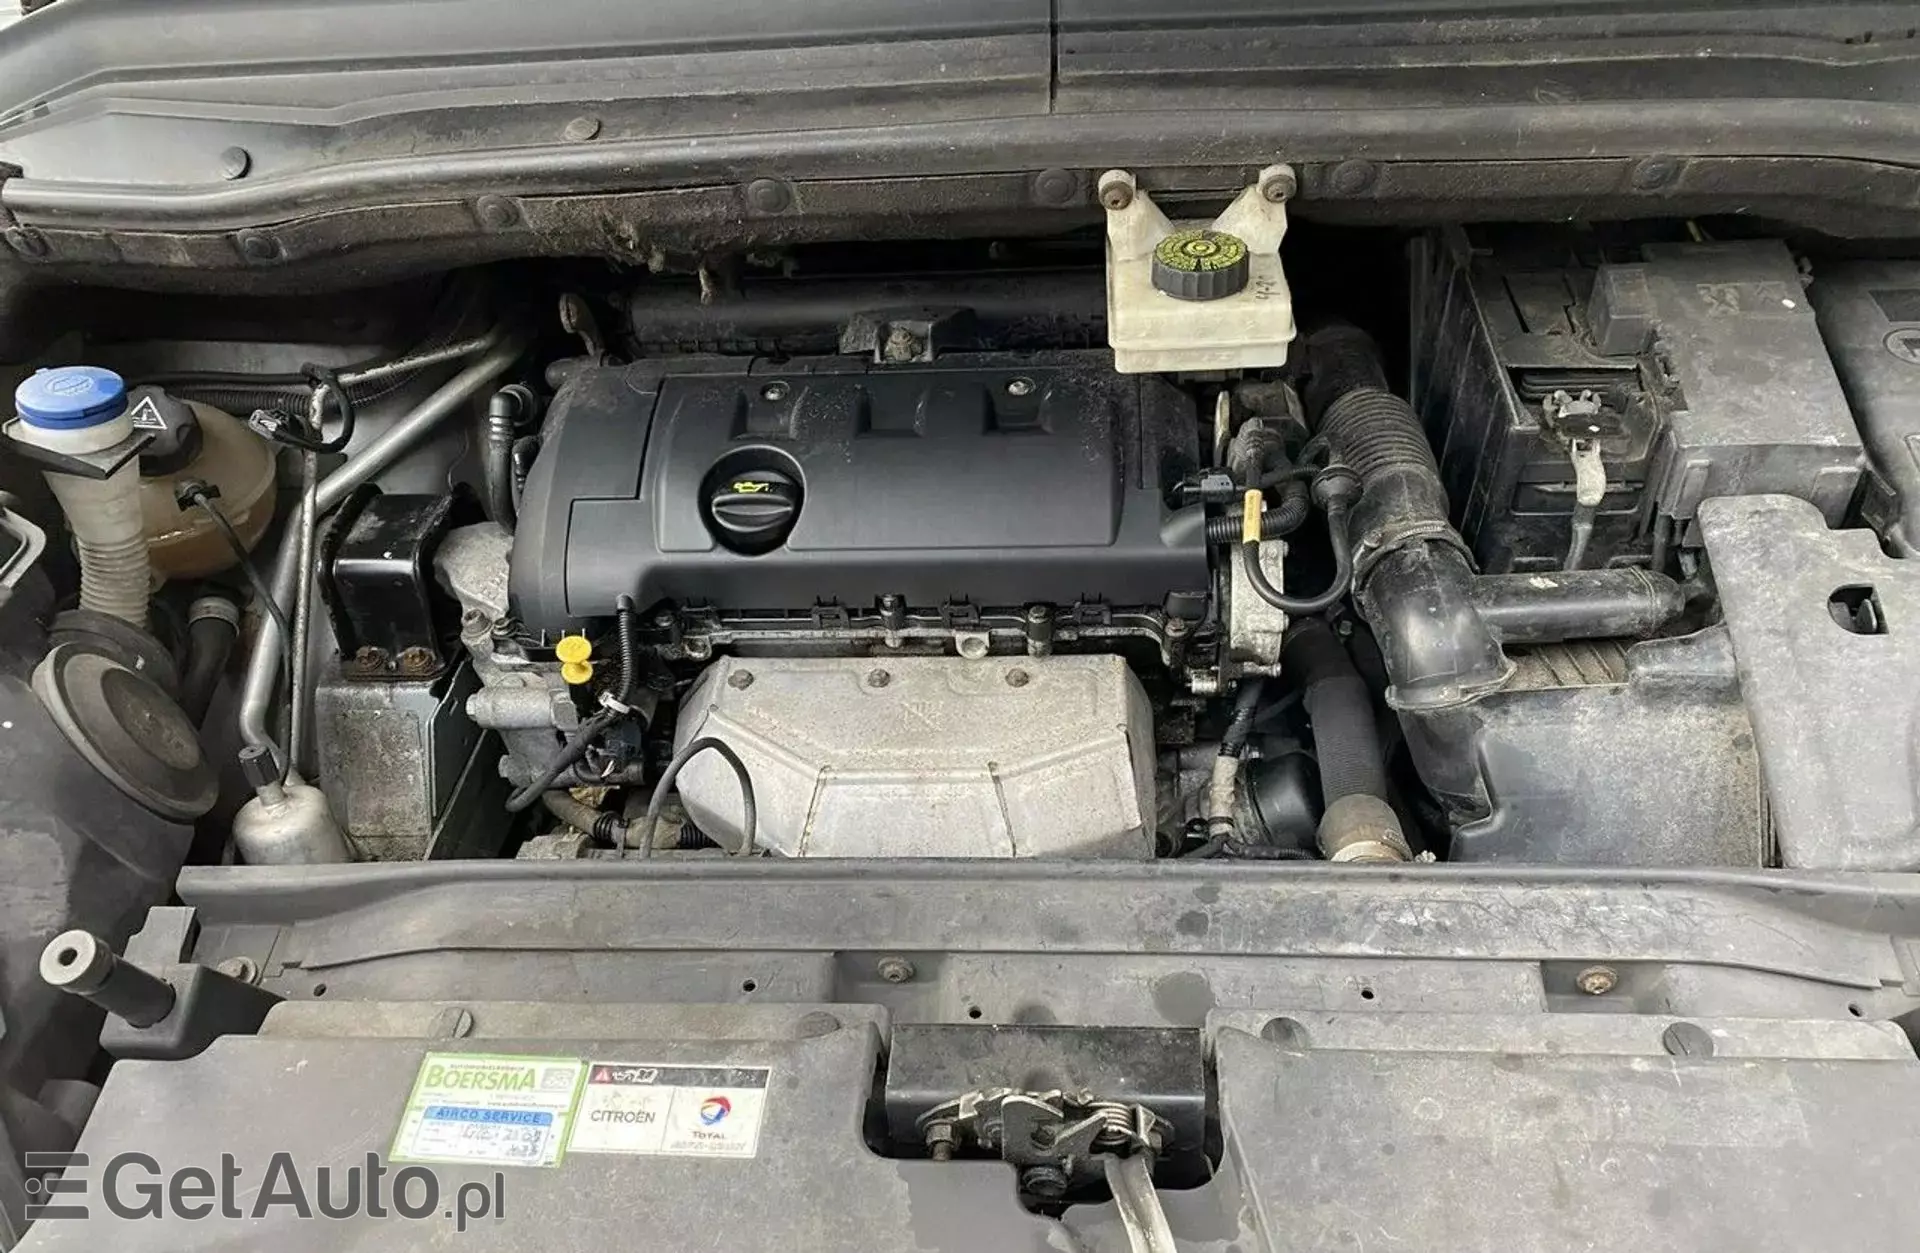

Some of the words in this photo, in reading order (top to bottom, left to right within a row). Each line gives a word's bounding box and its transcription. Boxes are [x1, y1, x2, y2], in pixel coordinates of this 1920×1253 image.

[424, 1063, 537, 1092] BOERSMA
[435, 1107, 479, 1121] AIRCO
[482, 1111, 543, 1124] SERVICE
[589, 1108, 656, 1124] CITROËN
[691, 1130, 726, 1140] TOTAL
